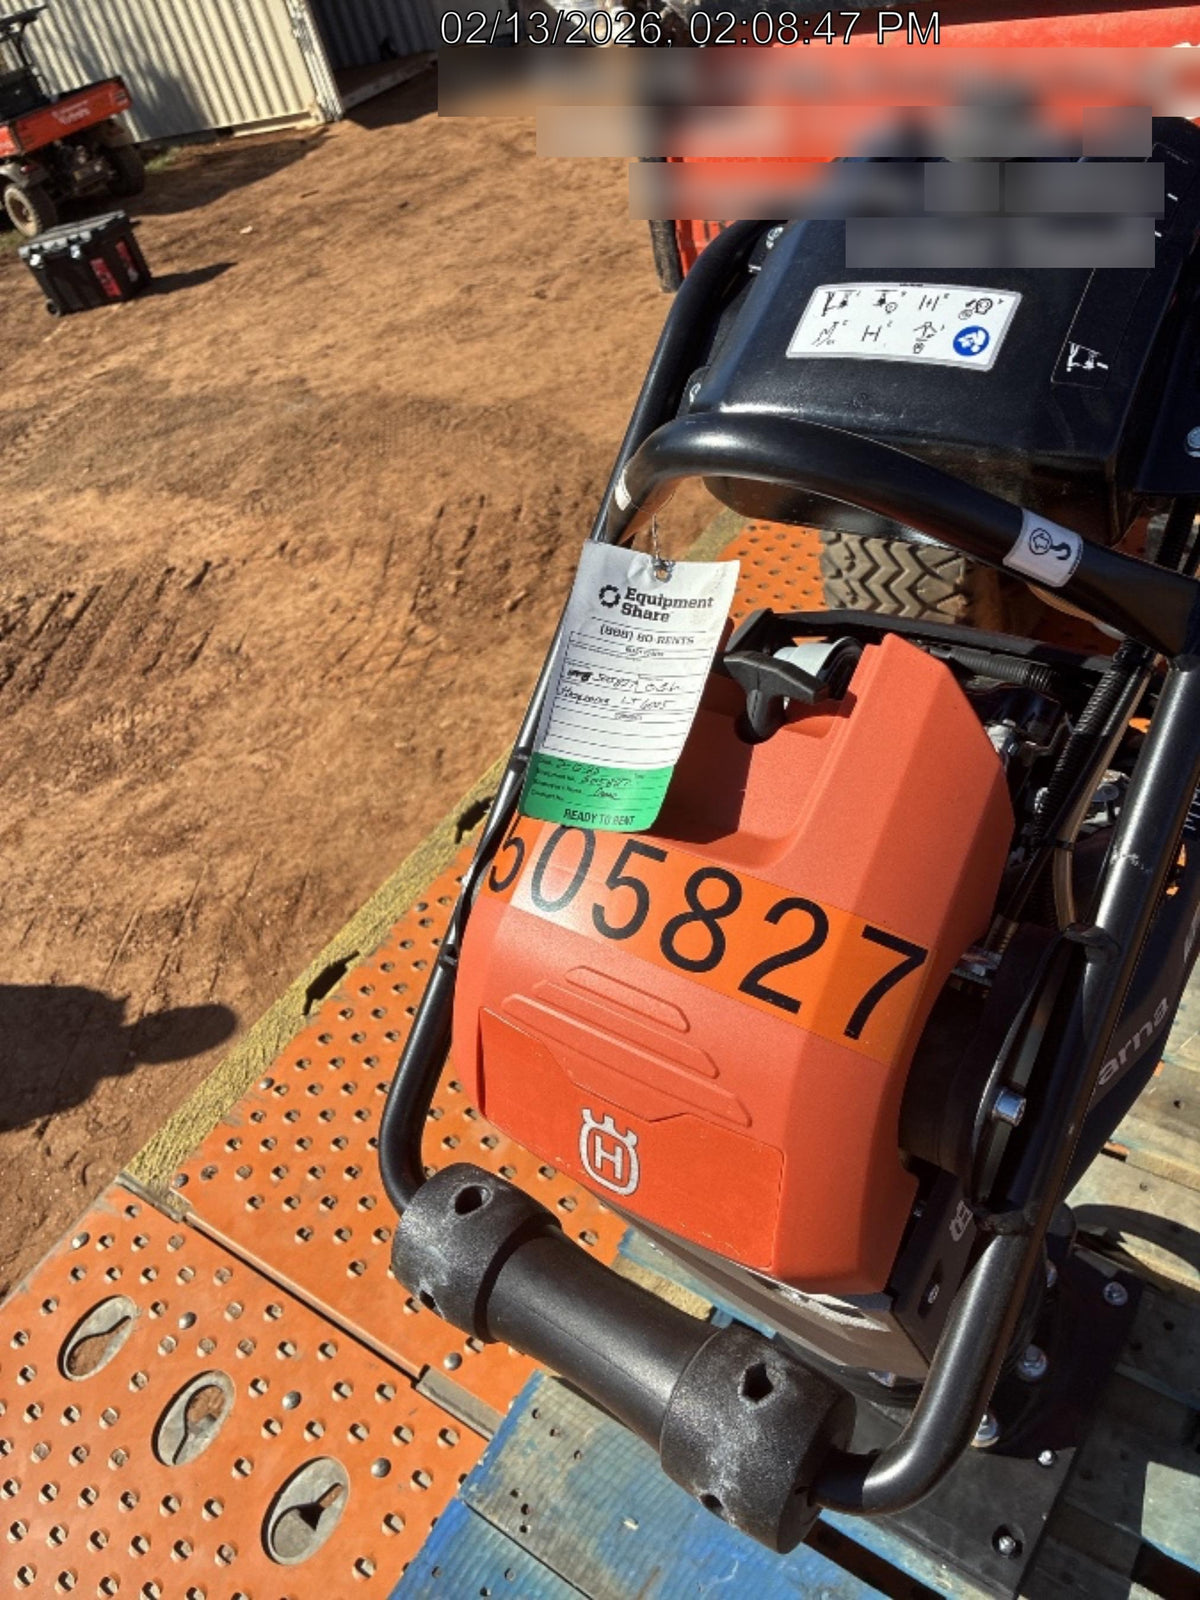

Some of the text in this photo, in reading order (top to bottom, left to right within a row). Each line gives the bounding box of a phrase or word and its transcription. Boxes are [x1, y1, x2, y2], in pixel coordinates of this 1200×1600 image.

[624, 586, 714, 610] Equipment
[621, 602, 671, 623] Share
[563, 808, 636, 826] READY TO RENT
[488, 813, 928, 1040] 505827
[1097, 996, 1169, 1086] arna
